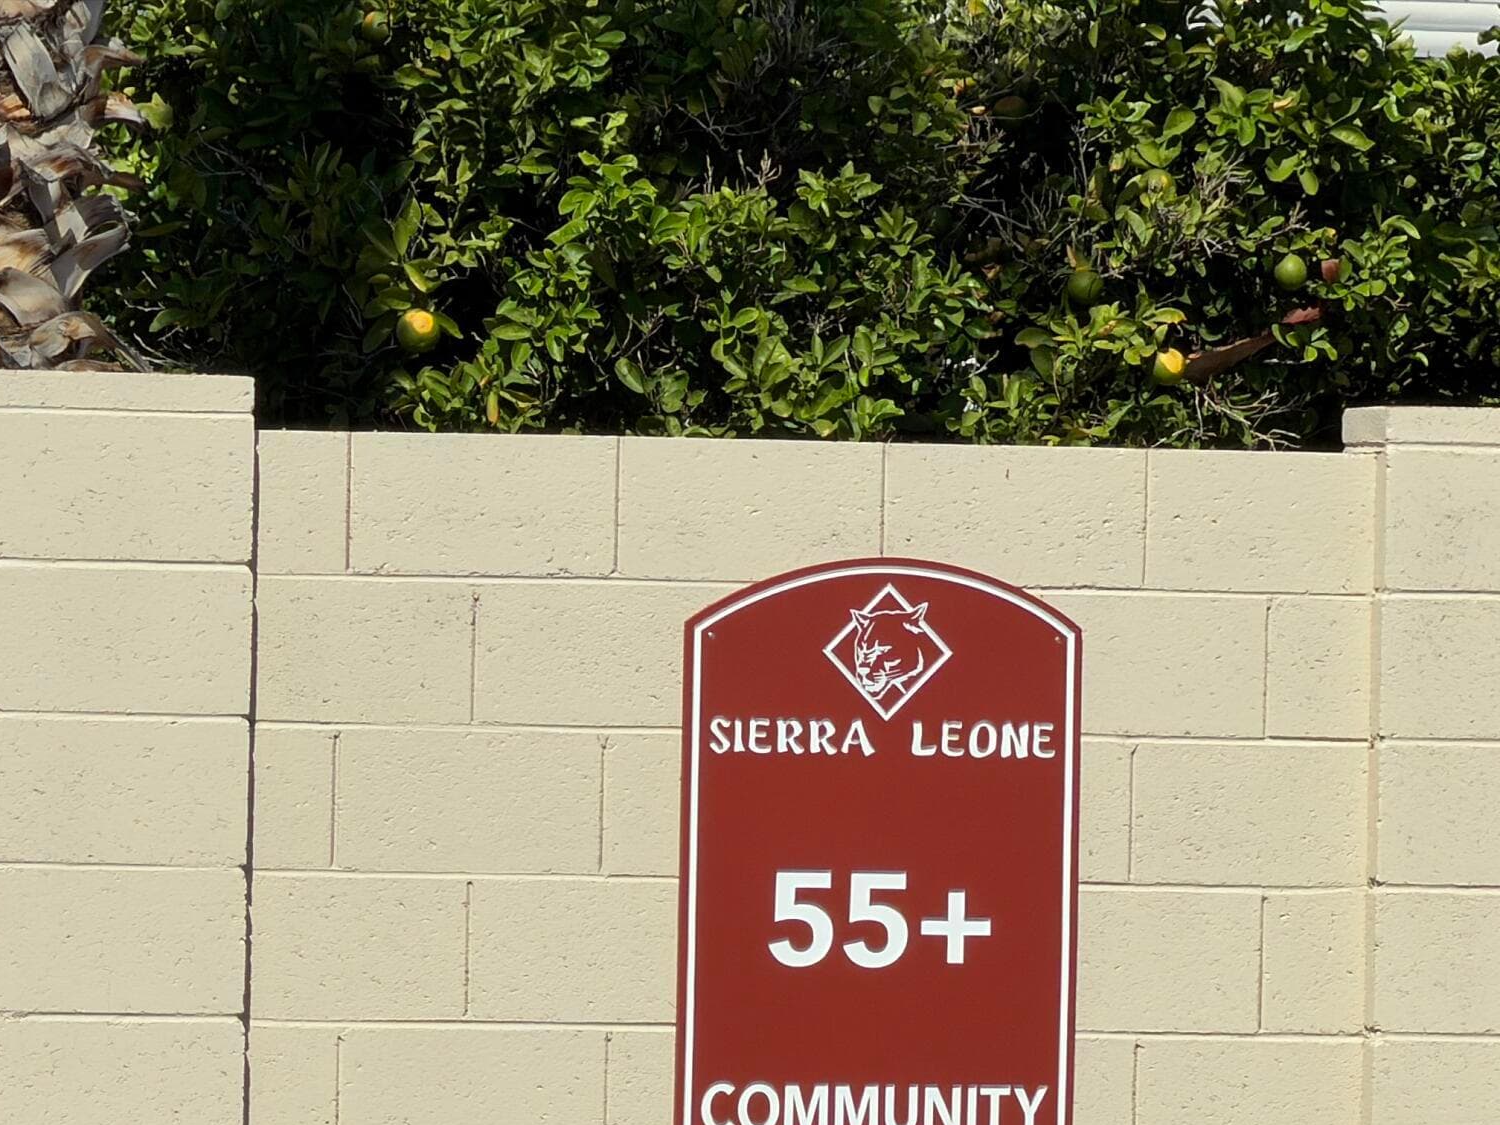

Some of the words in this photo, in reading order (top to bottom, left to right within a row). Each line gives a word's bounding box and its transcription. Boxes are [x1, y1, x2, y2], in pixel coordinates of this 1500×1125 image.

[708, 715, 877, 757] SIERRA
[911, 720, 1057, 760] LEONE
[767, 870, 993, 969] 55+
